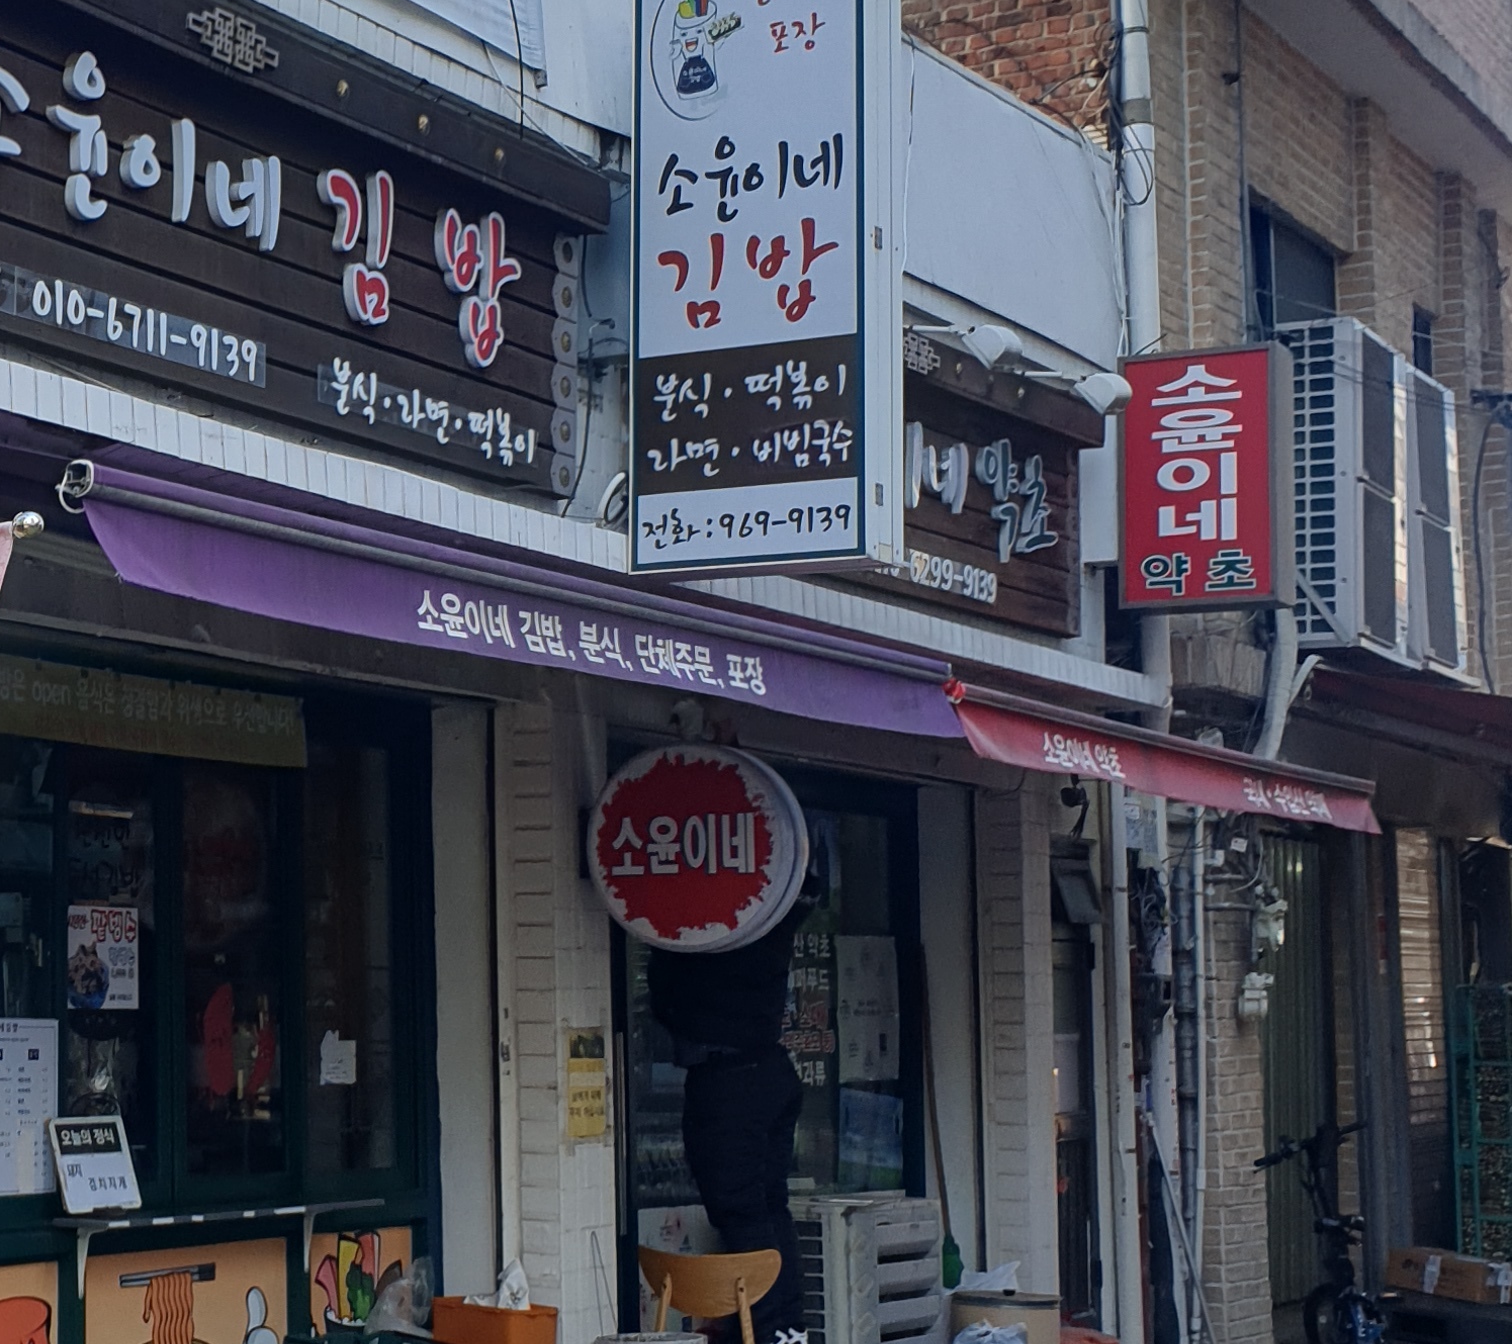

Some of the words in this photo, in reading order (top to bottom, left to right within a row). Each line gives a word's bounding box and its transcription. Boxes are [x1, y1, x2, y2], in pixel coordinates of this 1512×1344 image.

[770, 14, 826, 55] 포장
[659, 132, 845, 222] 소윤이네
[316, 167, 522, 369] 김밥
[658, 217, 841, 331] 김밥
[31, 278, 259, 383] 010-6711-9139
[752, 419, 854, 469] 비빔국수
[1150, 364, 1244, 541] 소윤이네
[975, 437, 1060, 564] 약초
[909, 549, 998, 605] 6299-9139
[416, 589, 516, 649] 소윤이네
[518, 609, 577, 662] 김밥,
[577, 621, 634, 673] 분식,
[634, 634, 725, 689] 단체주문,
[726, 652, 768, 697] 포장
[611, 812, 756, 877] 소윤이네
[90, 908, 137, 944] 팥빙수
[92, 1127, 115, 1146] 정식
